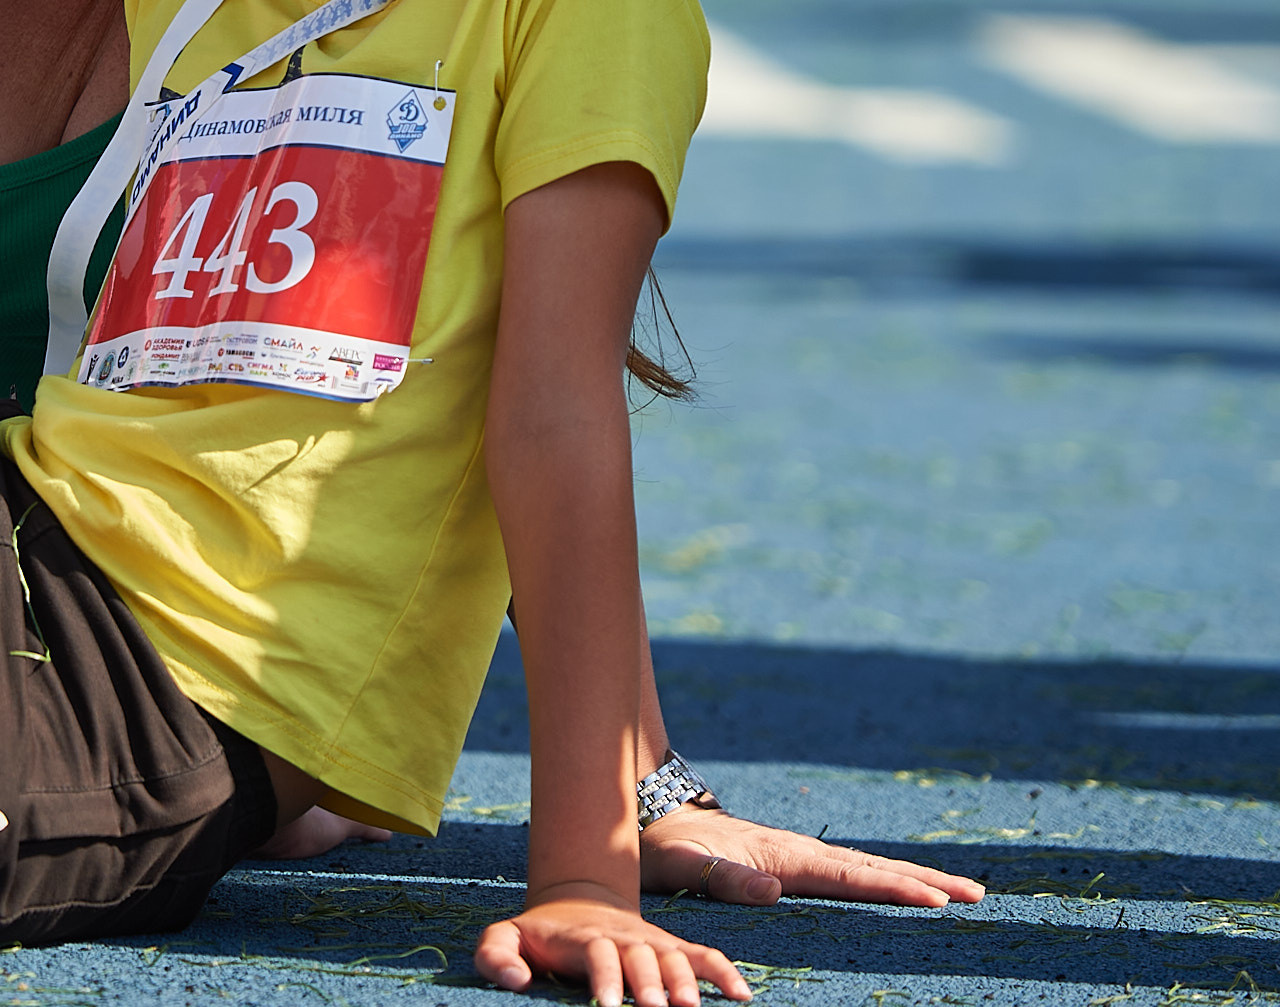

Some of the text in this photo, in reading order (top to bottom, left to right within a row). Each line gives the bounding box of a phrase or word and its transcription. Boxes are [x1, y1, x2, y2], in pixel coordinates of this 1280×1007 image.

[177, 108, 293, 144] Динамовкая
[151, 181, 319, 300] 443
[263, 337, 303, 350] СМАЙЛ
